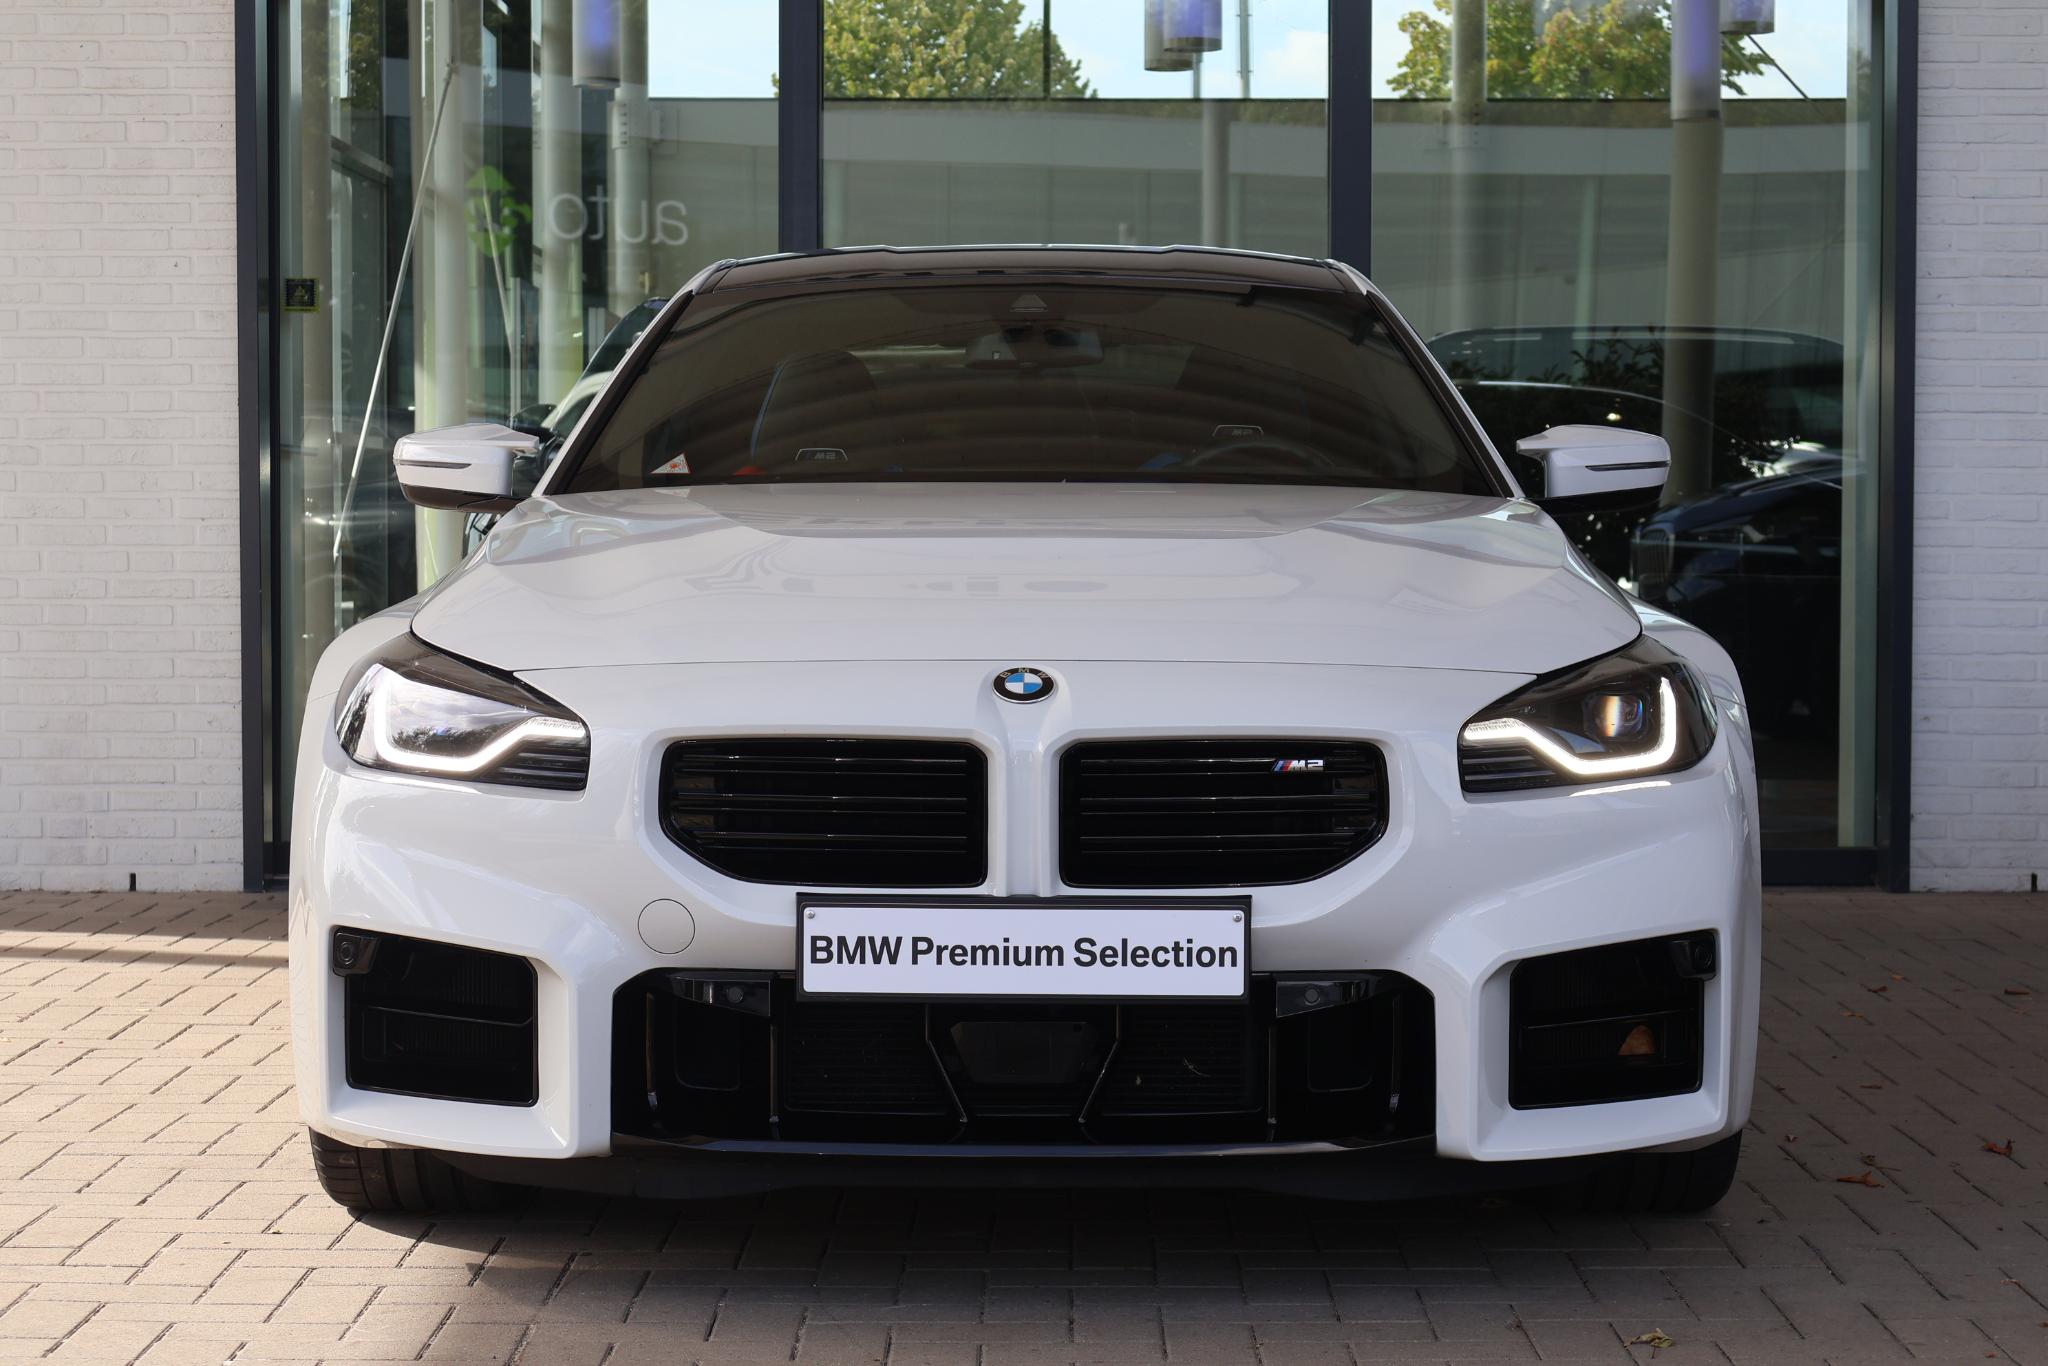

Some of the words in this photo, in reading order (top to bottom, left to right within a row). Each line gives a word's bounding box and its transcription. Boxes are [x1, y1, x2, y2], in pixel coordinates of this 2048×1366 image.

[999, 667, 1050, 679] BMW
[1287, 759, 1324, 771] M2
[810, 935, 903, 965] BMW
[911, 936, 1065, 967] Premium
[1073, 937, 1238, 968] Selection
